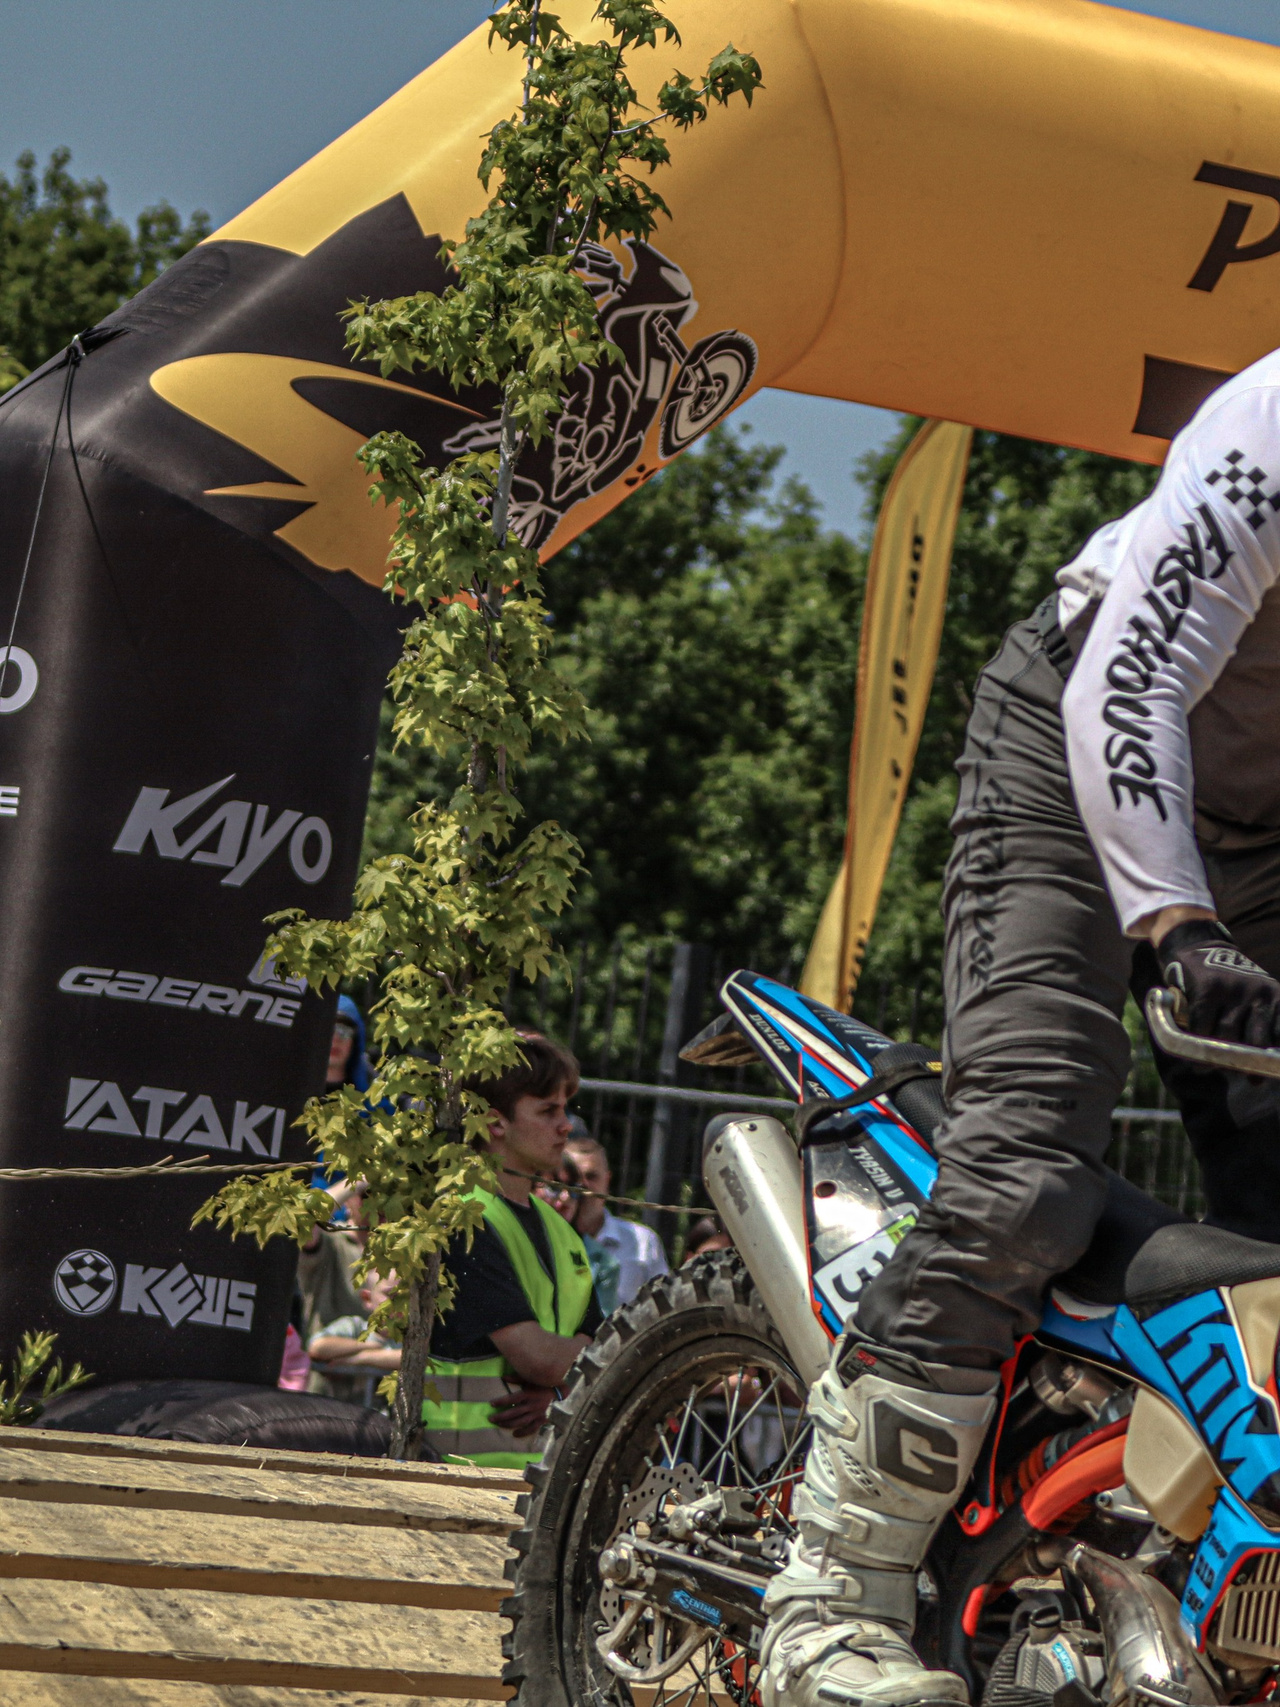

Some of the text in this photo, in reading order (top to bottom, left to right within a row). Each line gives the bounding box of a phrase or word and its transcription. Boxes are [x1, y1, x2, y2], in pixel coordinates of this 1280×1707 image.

[1103, 503, 1235, 822] FASTHOUSE
[112, 773, 333, 888] KAYO
[749, 1013, 792, 1053] DUNLOP
[64, 1076, 287, 1159] ATAKI
[849, 1146, 894, 1187] TYASIN
